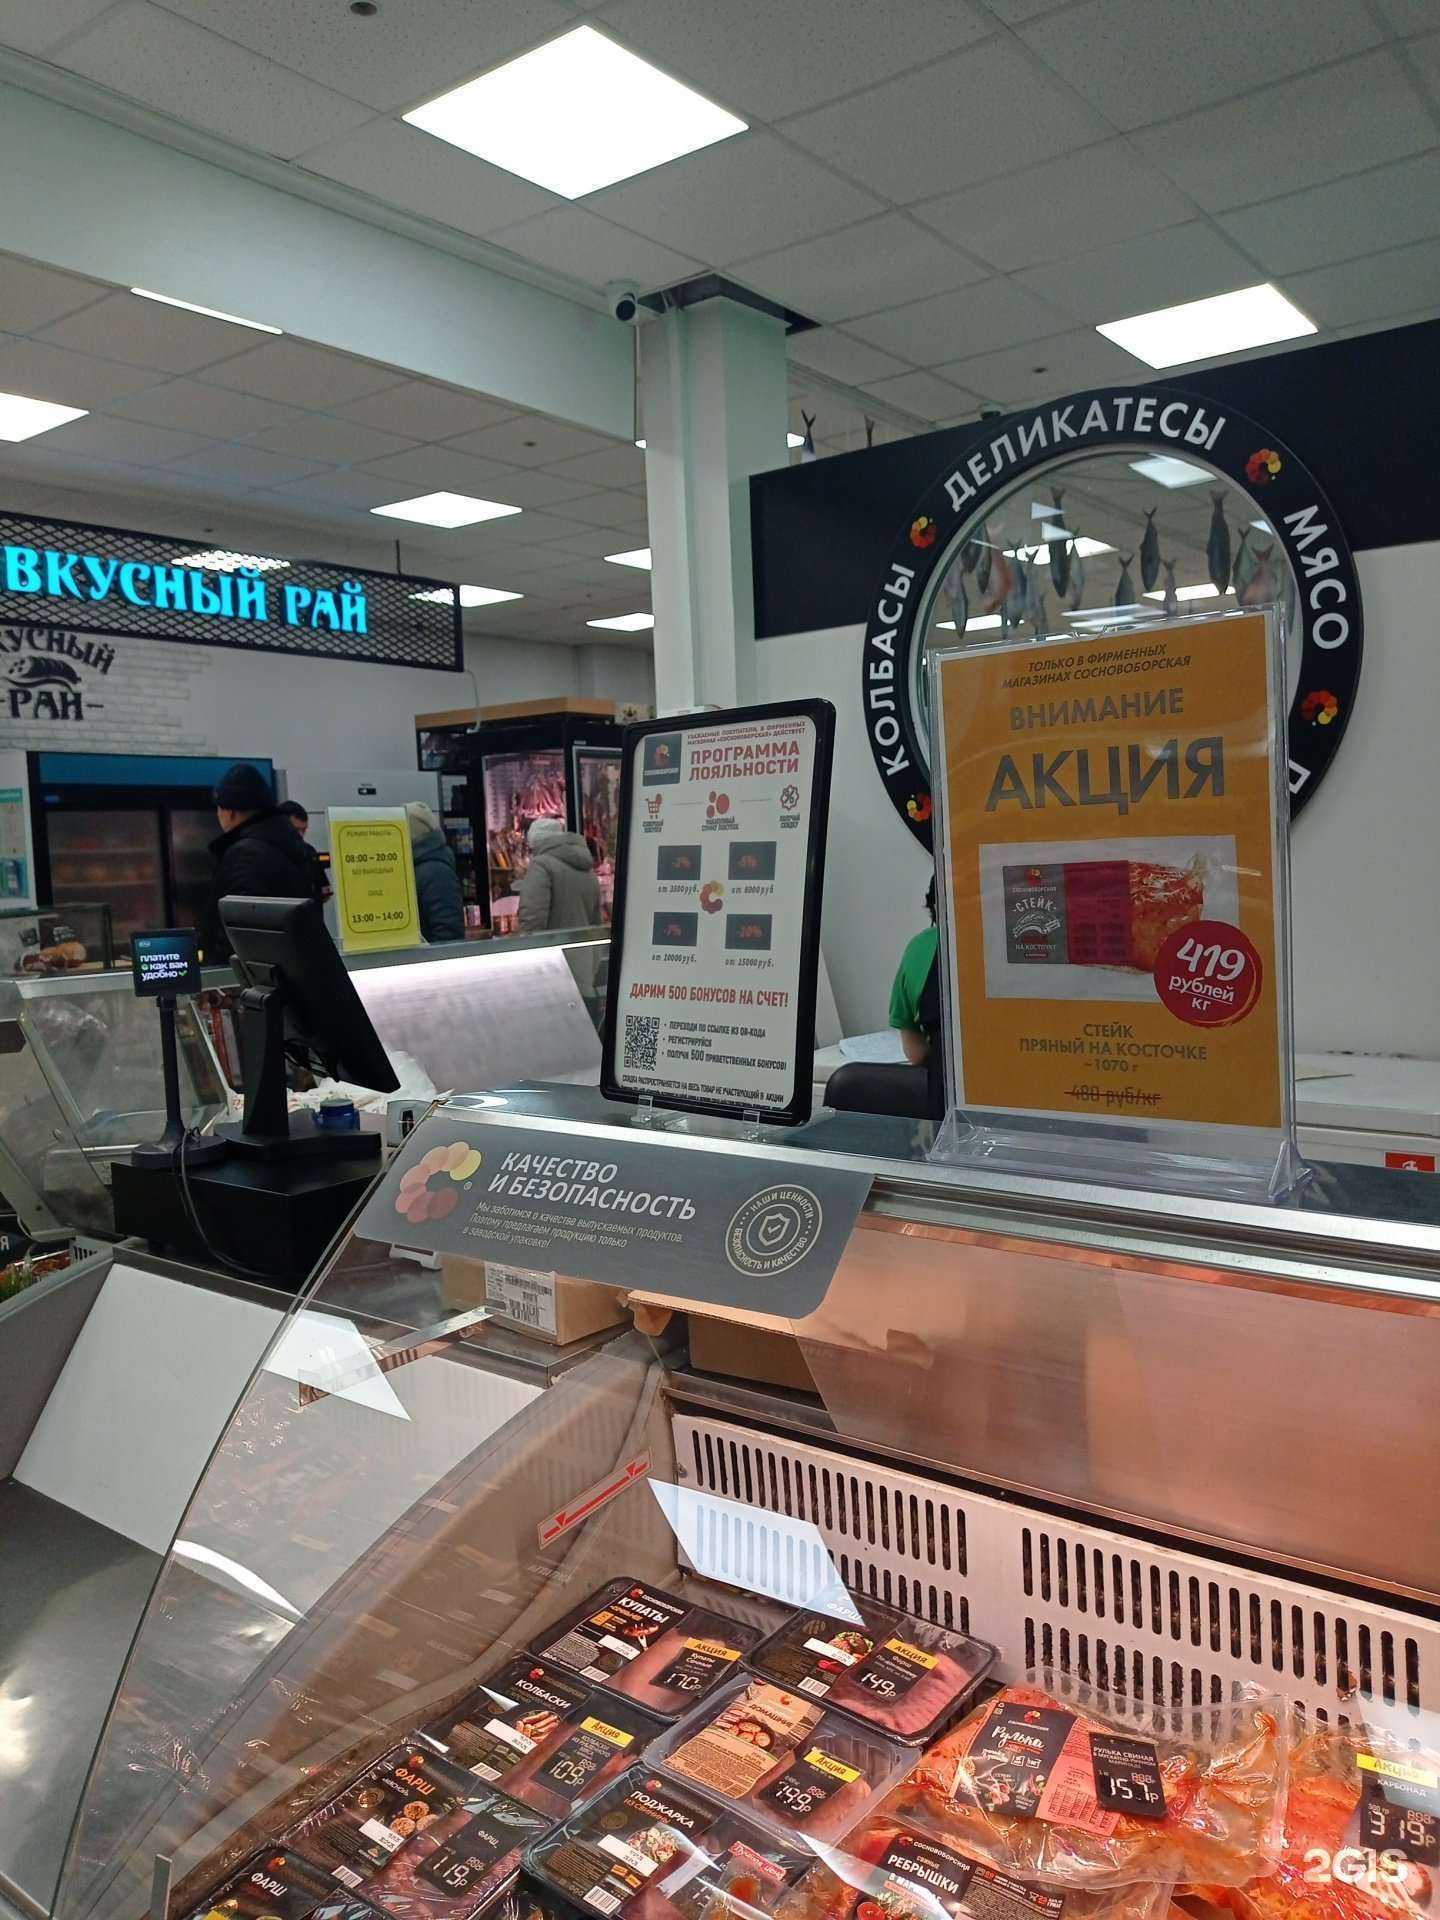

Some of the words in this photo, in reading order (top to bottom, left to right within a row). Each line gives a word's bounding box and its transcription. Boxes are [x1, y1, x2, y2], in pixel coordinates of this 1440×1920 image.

[943, 396, 1228, 512] ДЕЛИКАТЕСЫ
[4, 546, 268, 621] ВКУСНЫЙ
[284, 581, 367, 634] РАЙ
[1282, 504, 1350, 650] МЯСО
[869, 562, 915, 777] КОЛБАСЫ
[1028, 658, 1073, 673] ТОЛЬКО
[1076, 654, 1085, 667] В
[1087, 643, 1168, 666] ФИРМЕННЫХ
[1002, 671, 1071, 689] МАГАЗИНАХ
[1073, 655, 1191, 680] СОСНОВОБОРСКАЯ
[1009, 687, 1184, 730] ВНИМАНИЕ
[691, 740, 800, 765] ПРОГРАММА
[689, 758, 799, 781] ЛОЯЛЬНОСТИ
[984, 736, 1224, 816] АКЦИЯ
[345, 853, 368, 863] 08:00
[376, 852, 398, 862] 20:00
[352, 913, 374, 923] 13:00
[382, 911, 404, 921] 14:00
[1015, 897, 1053, 912] СТЕЙК
[140, 953, 180, 962] платите
[169, 961, 188, 969] вам
[1176, 937, 1246, 982] 419
[141, 969, 178, 981] удобно
[1168, 974, 1235, 1002] рублей
[630, 983, 666, 999] ДАРИМ
[668, 985, 688, 1001] 500
[690, 987, 737, 1005] БОНУСОВ
[739, 990, 754, 1005] НА
[756, 990, 789, 1008] СЧЕТ!
[1191, 996, 1212, 1011] кг
[1083, 1021, 1134, 1038] СТЕЙК
[690, 1049, 705, 1062] 500
[1019, 1037, 1084, 1055] ПРЯНЫЙ
[1089, 1043, 1111, 1055] НА
[1117, 1044, 1207, 1061] КОСТОЧКЕ
[500, 1152, 618, 1184] КАЧЕСТВО
[487, 1174, 506, 1193] И
[508, 1176, 697, 1221] БЕЗОПАСНОСТЬ
[750, 1191, 778, 1212] НАШИ
[779, 1191, 815, 1219] ЦЕННОСТИ
[476, 1202, 489, 1212] Мы
[578, 1218, 636, 1235] выпускаемых
[598, 1233, 628, 1248] только
[771, 1237, 808, 1268] КАЧЕСТВО
[617, 1597, 671, 1624] КУПАТЫ
[693, 1641, 729, 1657] АКЦИЯ
[893, 1644, 929, 1664] АКЦИЯ
[514, 1678, 573, 1710] КОЛБАСКИ
[991, 1725, 1045, 1749] Рулька
[394, 1767, 436, 1796] ФАРШ
[1377, 1778, 1427, 1798] КАРБОНАД
[629, 1790, 695, 1829] ПОДЖАРКА
[913, 1841, 971, 1872] СОСНОВОБОРСКАЯ
[251, 1871, 289, 1898] ФАРШ
[887, 1853, 960, 1895] РЕБРЫШКИ
